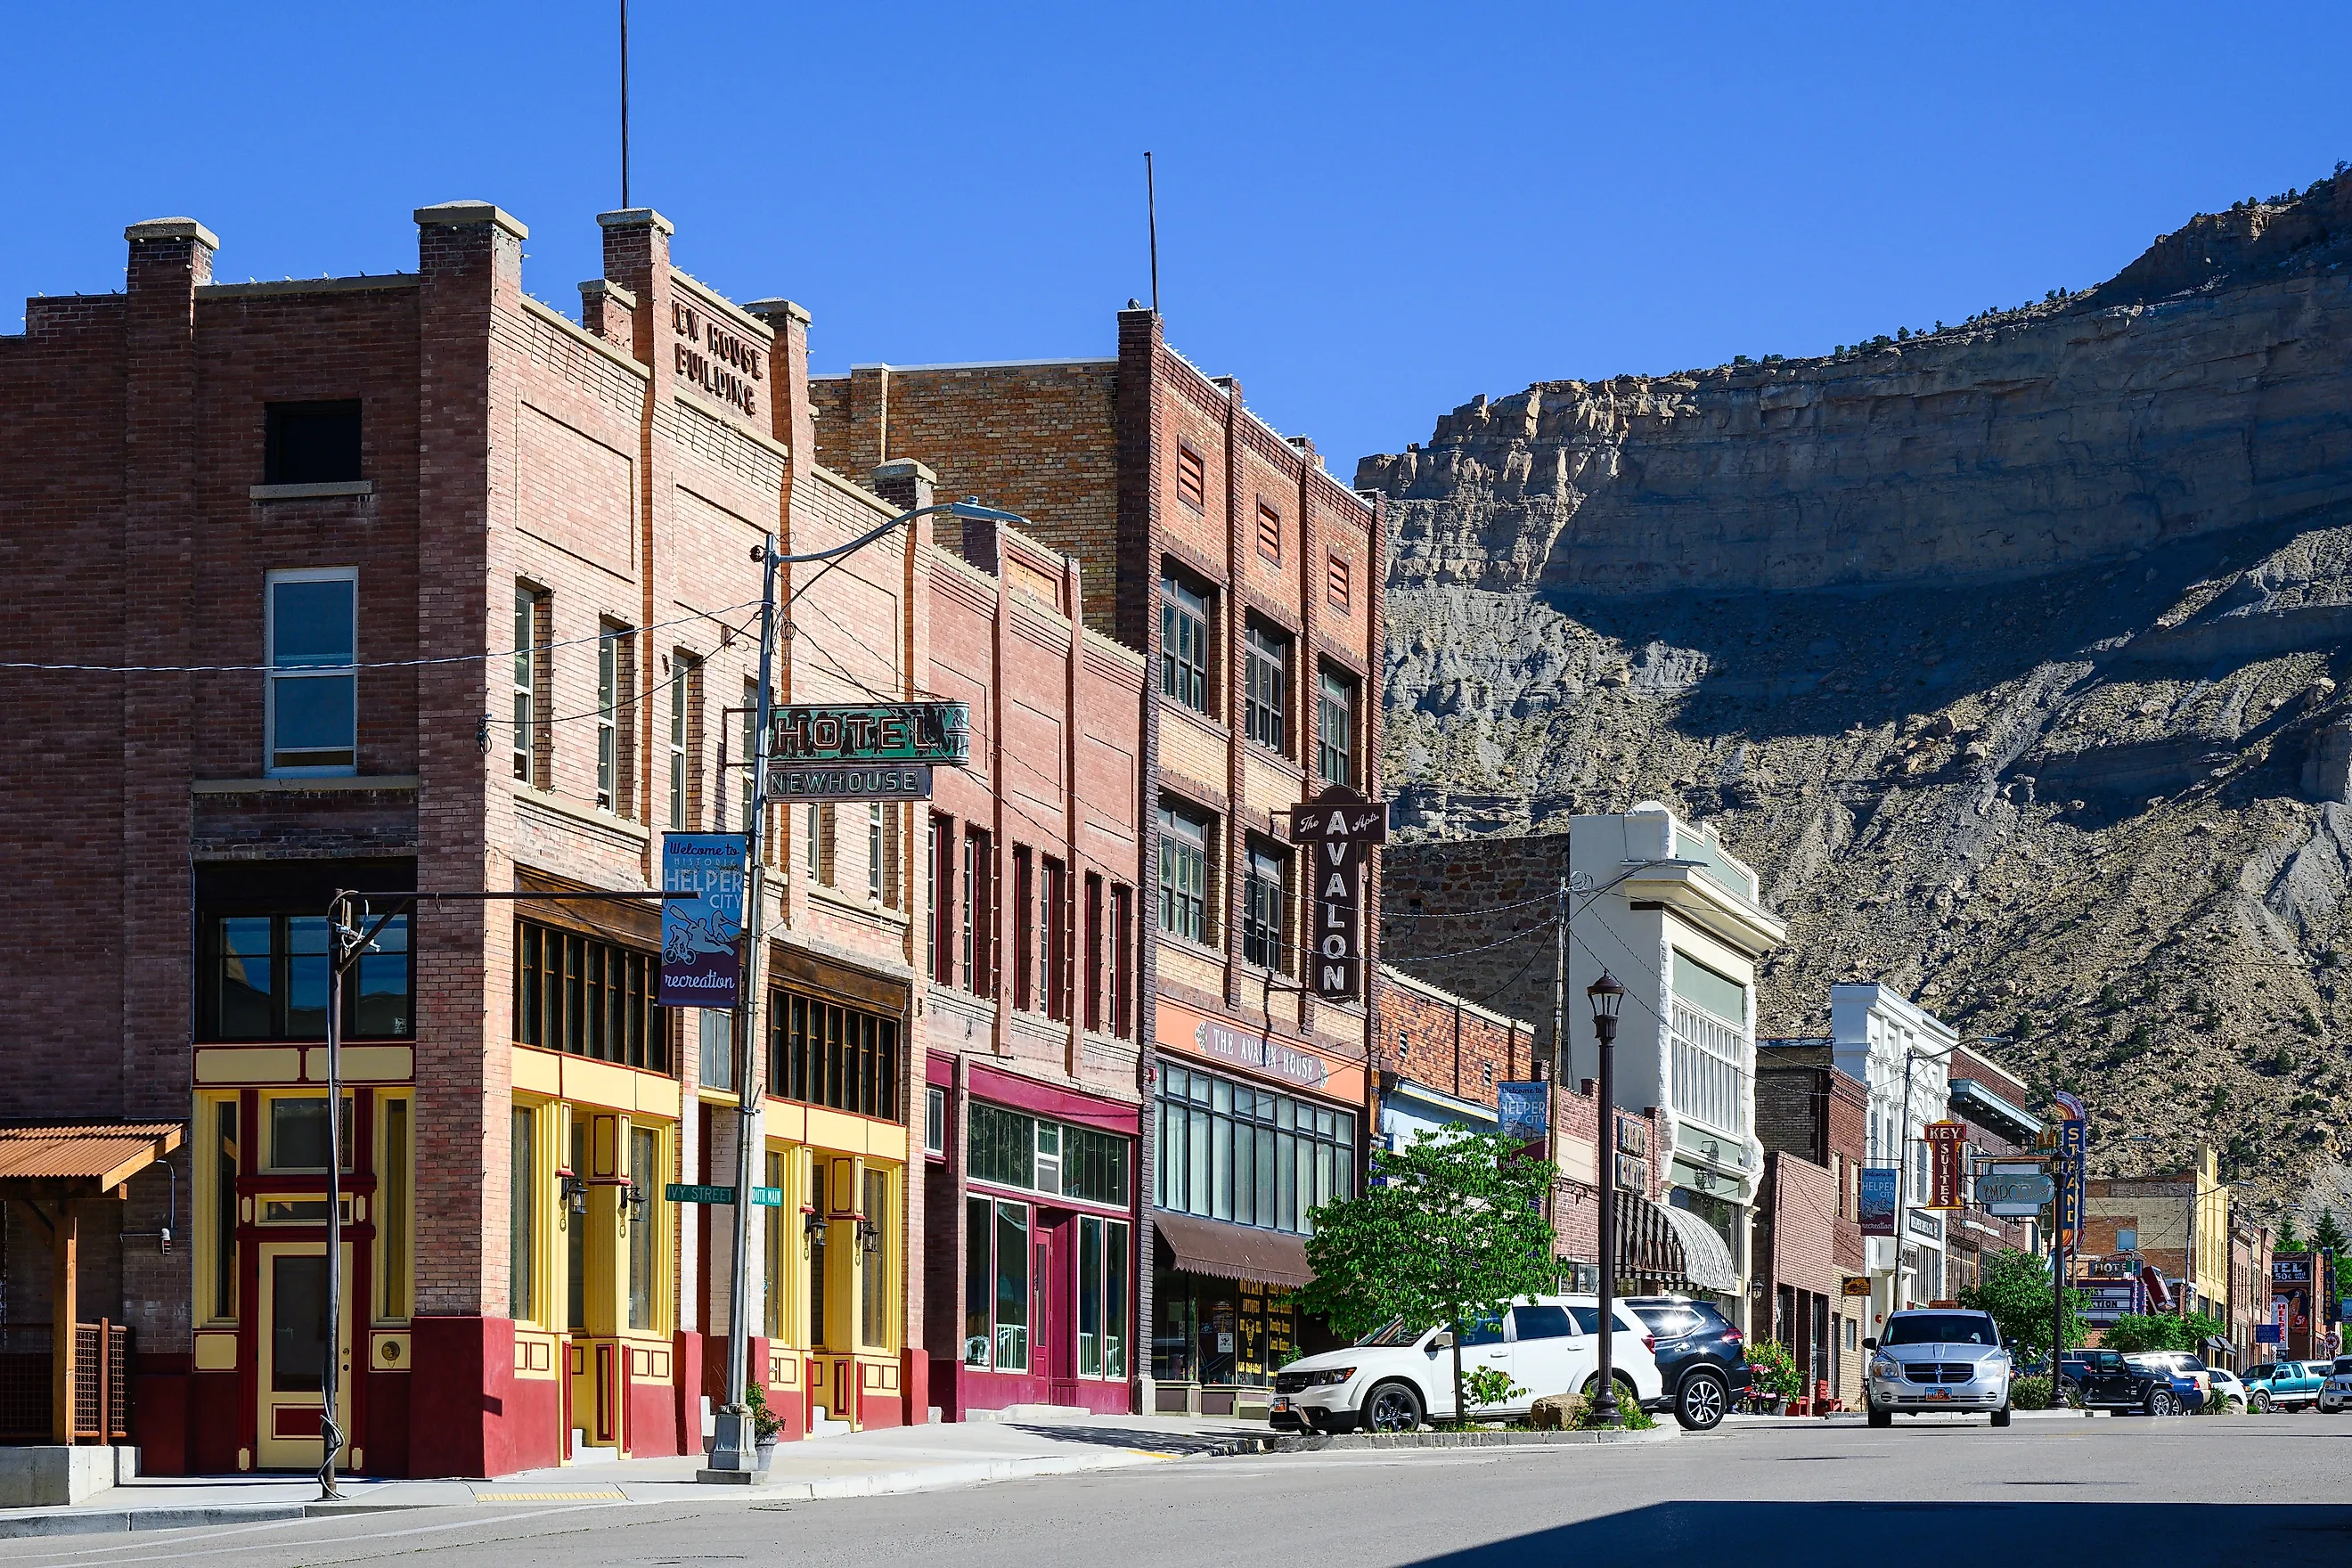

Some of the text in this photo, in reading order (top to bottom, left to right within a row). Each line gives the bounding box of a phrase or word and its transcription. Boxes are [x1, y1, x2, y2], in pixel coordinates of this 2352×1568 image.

[707, 323, 764, 381] HOUSE
[674, 343, 756, 418] BUILDING
[776, 715, 940, 751] HOTEL
[771, 771, 919, 795] NEWHOUSE
[1299, 814, 1319, 833] The
[670, 842, 740, 855] Welcome to
[665, 869, 744, 893] HELPER
[709, 894, 743, 909] CITY
[1322, 811, 1350, 991] AVALON
[665, 968, 736, 989] recreation
[1213, 1028, 1313, 1080] THE AVALON HOUSE
[1501, 1086, 1544, 1094] Welcome to
[1499, 1101, 1546, 1115] HELPER
[1525, 1115, 1545, 1123] CITY
[1930, 1127, 1961, 1139] KEY
[1940, 1143, 1950, 1205] SUITES
[2067, 1127, 2080, 1222] STRAND
[667, 1187, 732, 1202] IVY STREET
[1863, 1182, 1895, 1191] HELPER
[751, 1188, 781, 1204] OUTH MAIN
[1862, 1221, 1893, 1229] recreation
[2094, 1262, 2129, 1273] HOTE
[2273, 1262, 2302, 1272] TEL
[2277, 1303, 2286, 1342] HELPER
